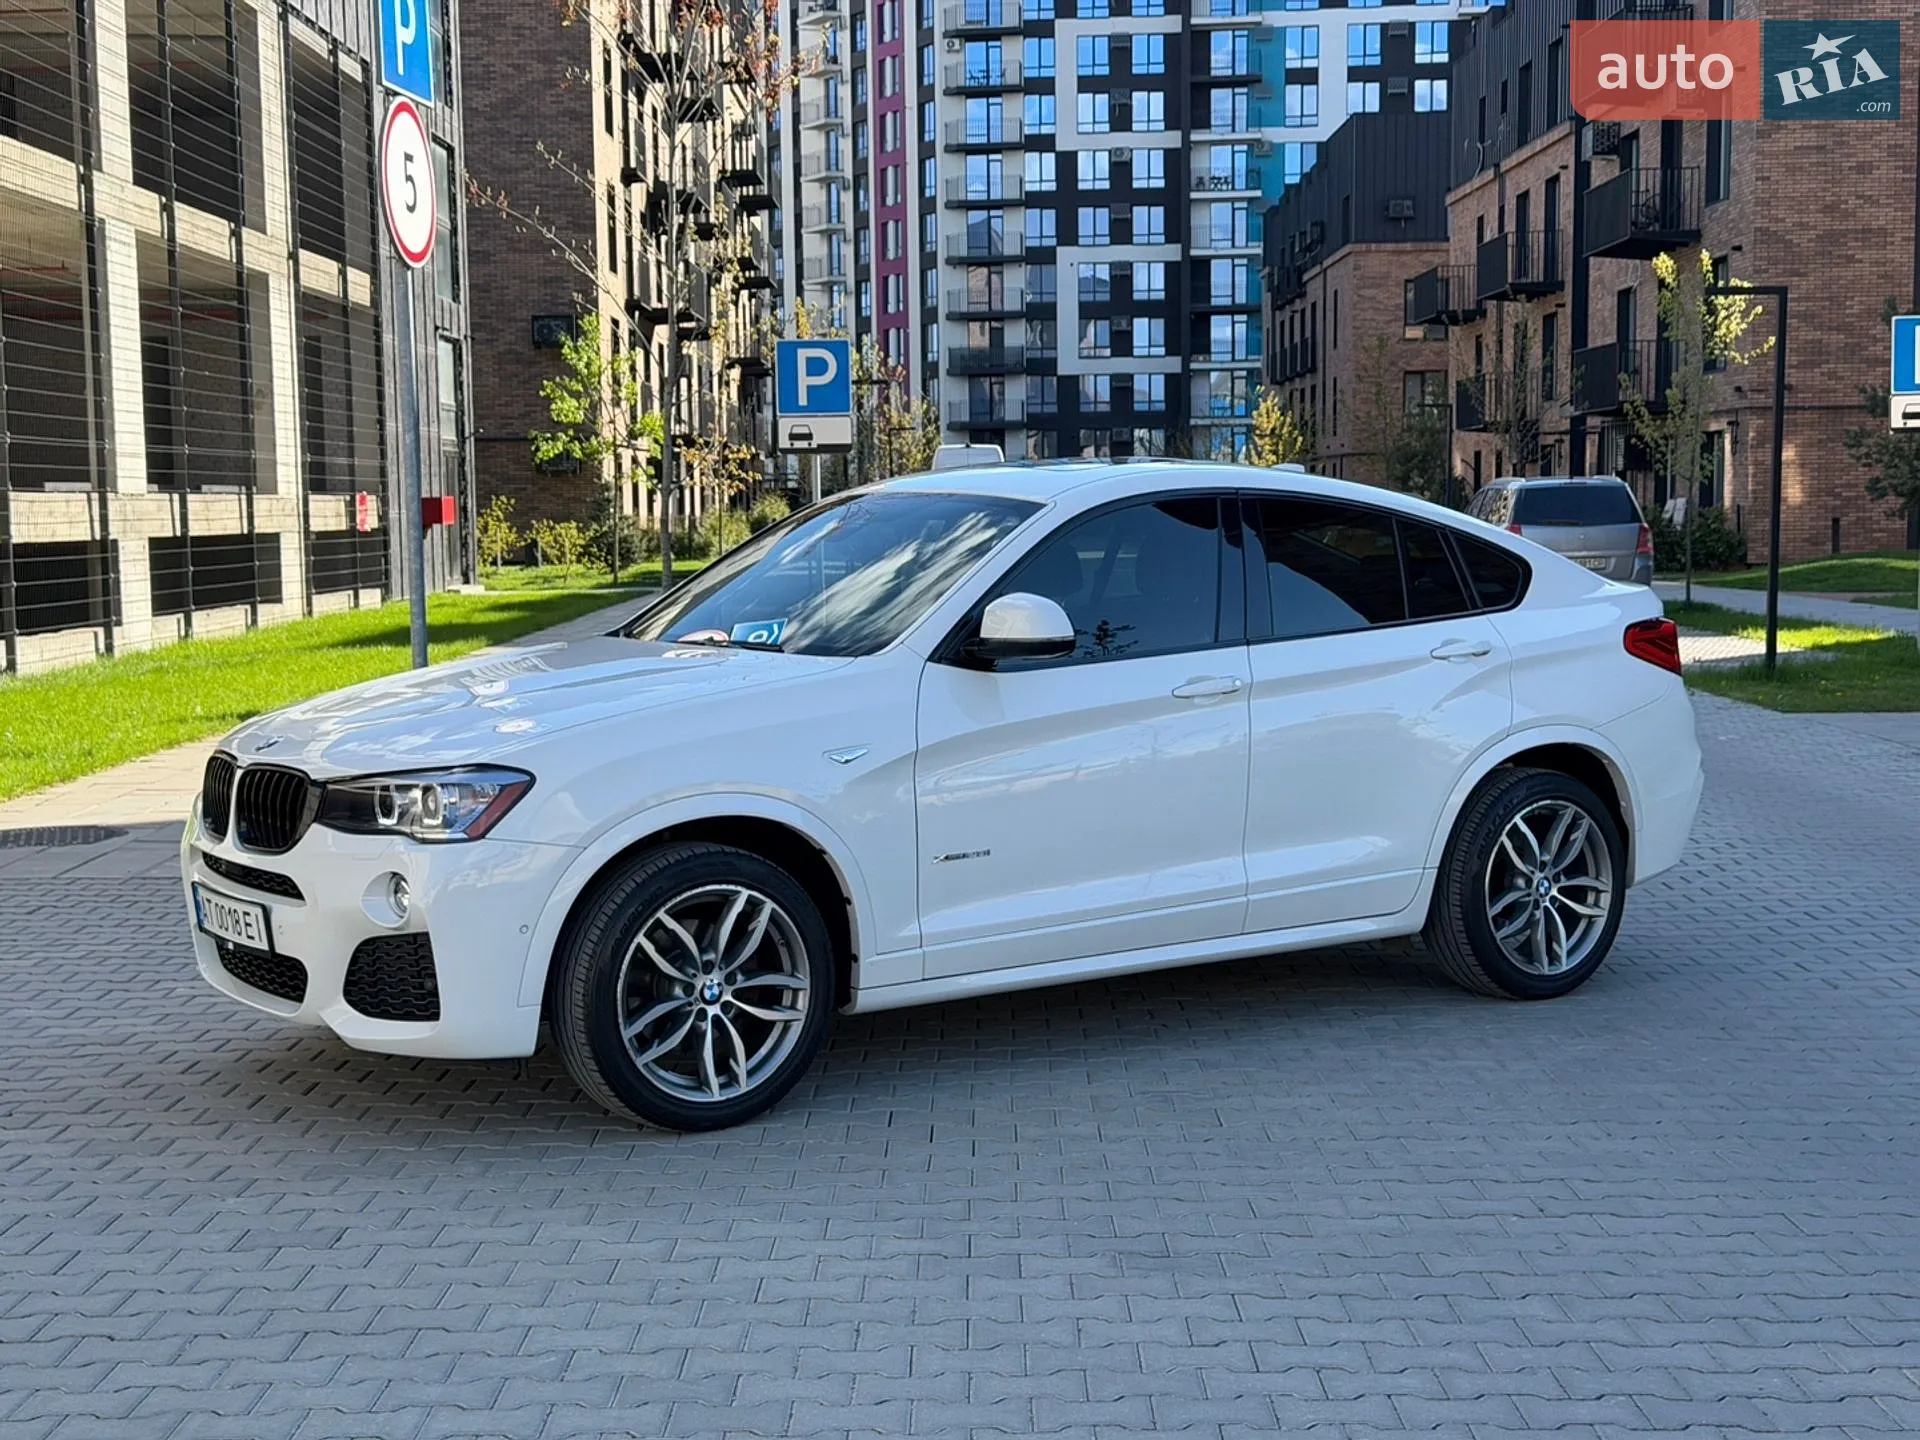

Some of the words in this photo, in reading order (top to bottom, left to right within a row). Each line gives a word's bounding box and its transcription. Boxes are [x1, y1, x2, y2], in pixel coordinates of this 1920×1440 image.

[394, 0, 416, 76] P
[403, 151, 417, 214] 5
[797, 348, 838, 407] P
